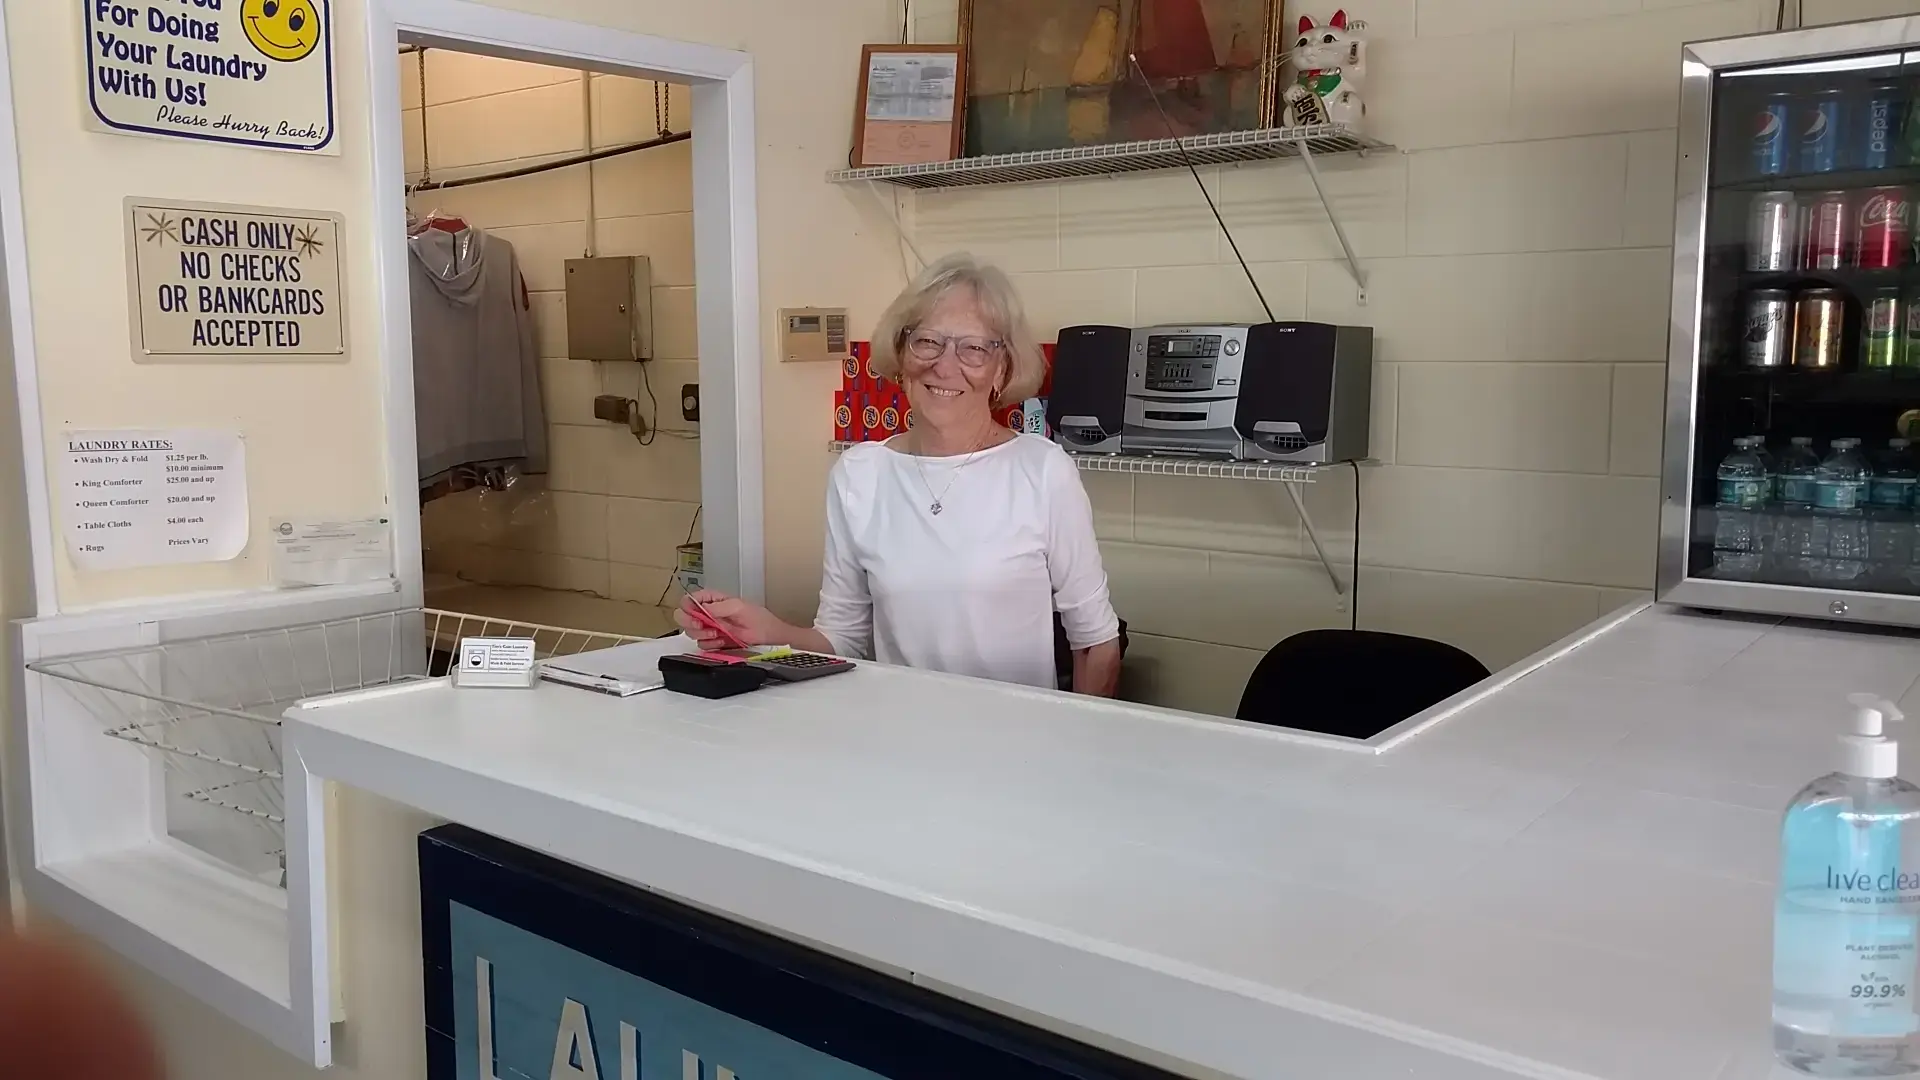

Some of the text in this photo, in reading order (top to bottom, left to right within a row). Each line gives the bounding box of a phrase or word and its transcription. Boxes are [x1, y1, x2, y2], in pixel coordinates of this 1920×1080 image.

[97, 0, 219, 43] For Doing
[97, 31, 267, 81] Your Laundry
[98, 66, 207, 107] With Us!
[156, 105, 325, 140] Please Hurry Back!
[1871, 100, 1889, 152] pepsi
[181, 217, 296, 250] CASH ONLY
[180, 251, 301, 283] NO CHECKS
[158, 284, 325, 315] OR BANKCARDS
[192, 319, 300, 348] ACCEPTED
[69, 440, 173, 451] LAUNDRY RATES:
[81, 456, 103, 464] Wash
[104, 456, 120, 465] Dry
[131, 455, 149, 463] Fold
[165, 454, 209, 463] $1.25 per lb.
[166, 464, 224, 473] $10.00 minimum
[82, 479, 143, 489] King Comforter
[166, 476, 190, 484] $25.00
[205, 477, 215, 485] up
[82, 499, 149, 509] Queen Comforter
[167, 496, 190, 504] $20.00
[84, 520, 132, 530] Table Cloths
[167, 517, 186, 525] $4.00
[168, 538, 210, 547] Prices Vary
[85, 545, 105, 553] Rugs
[1827, 864, 1920, 892] live clea
[1840, 896, 1871, 904] HAND
[1850, 984, 1906, 998] 99.9%
